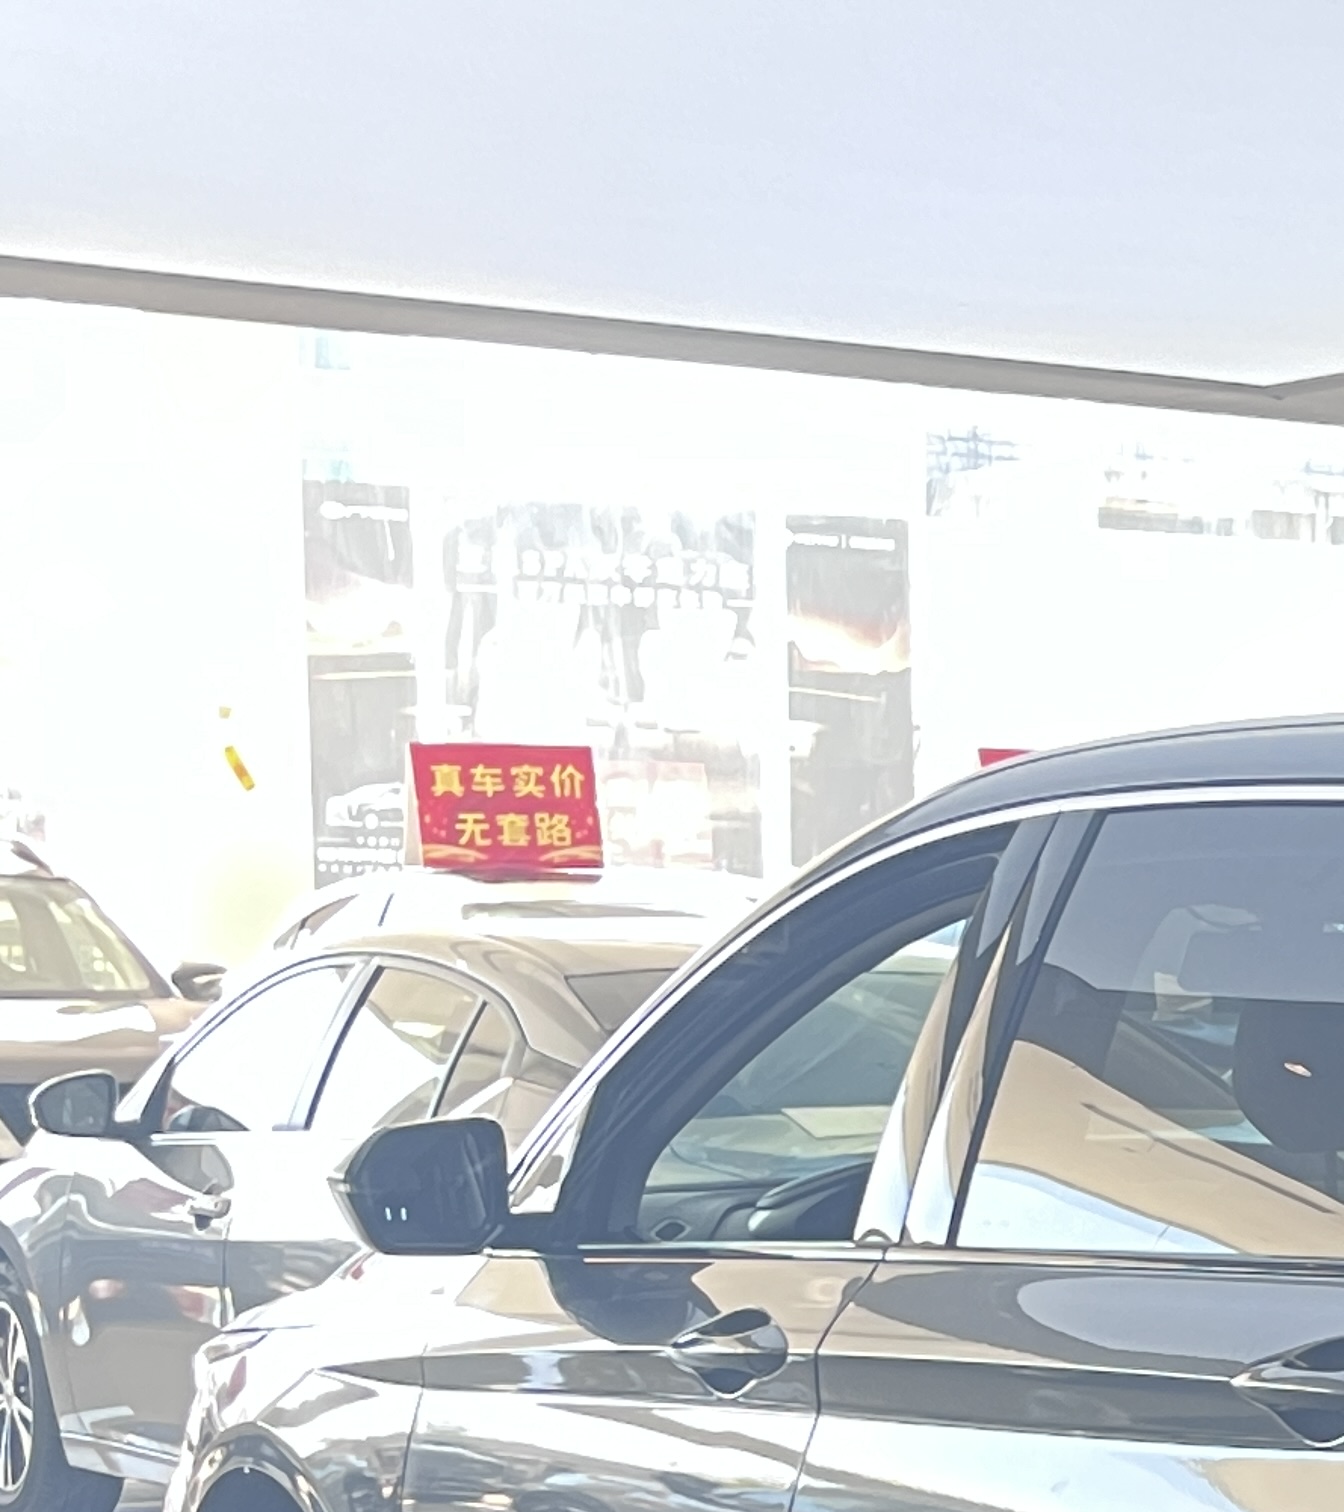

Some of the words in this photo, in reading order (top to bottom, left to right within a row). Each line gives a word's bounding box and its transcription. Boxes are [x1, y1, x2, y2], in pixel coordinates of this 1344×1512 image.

[430, 763, 585, 799] 真车实价
[455, 812, 572, 847] 无套路
